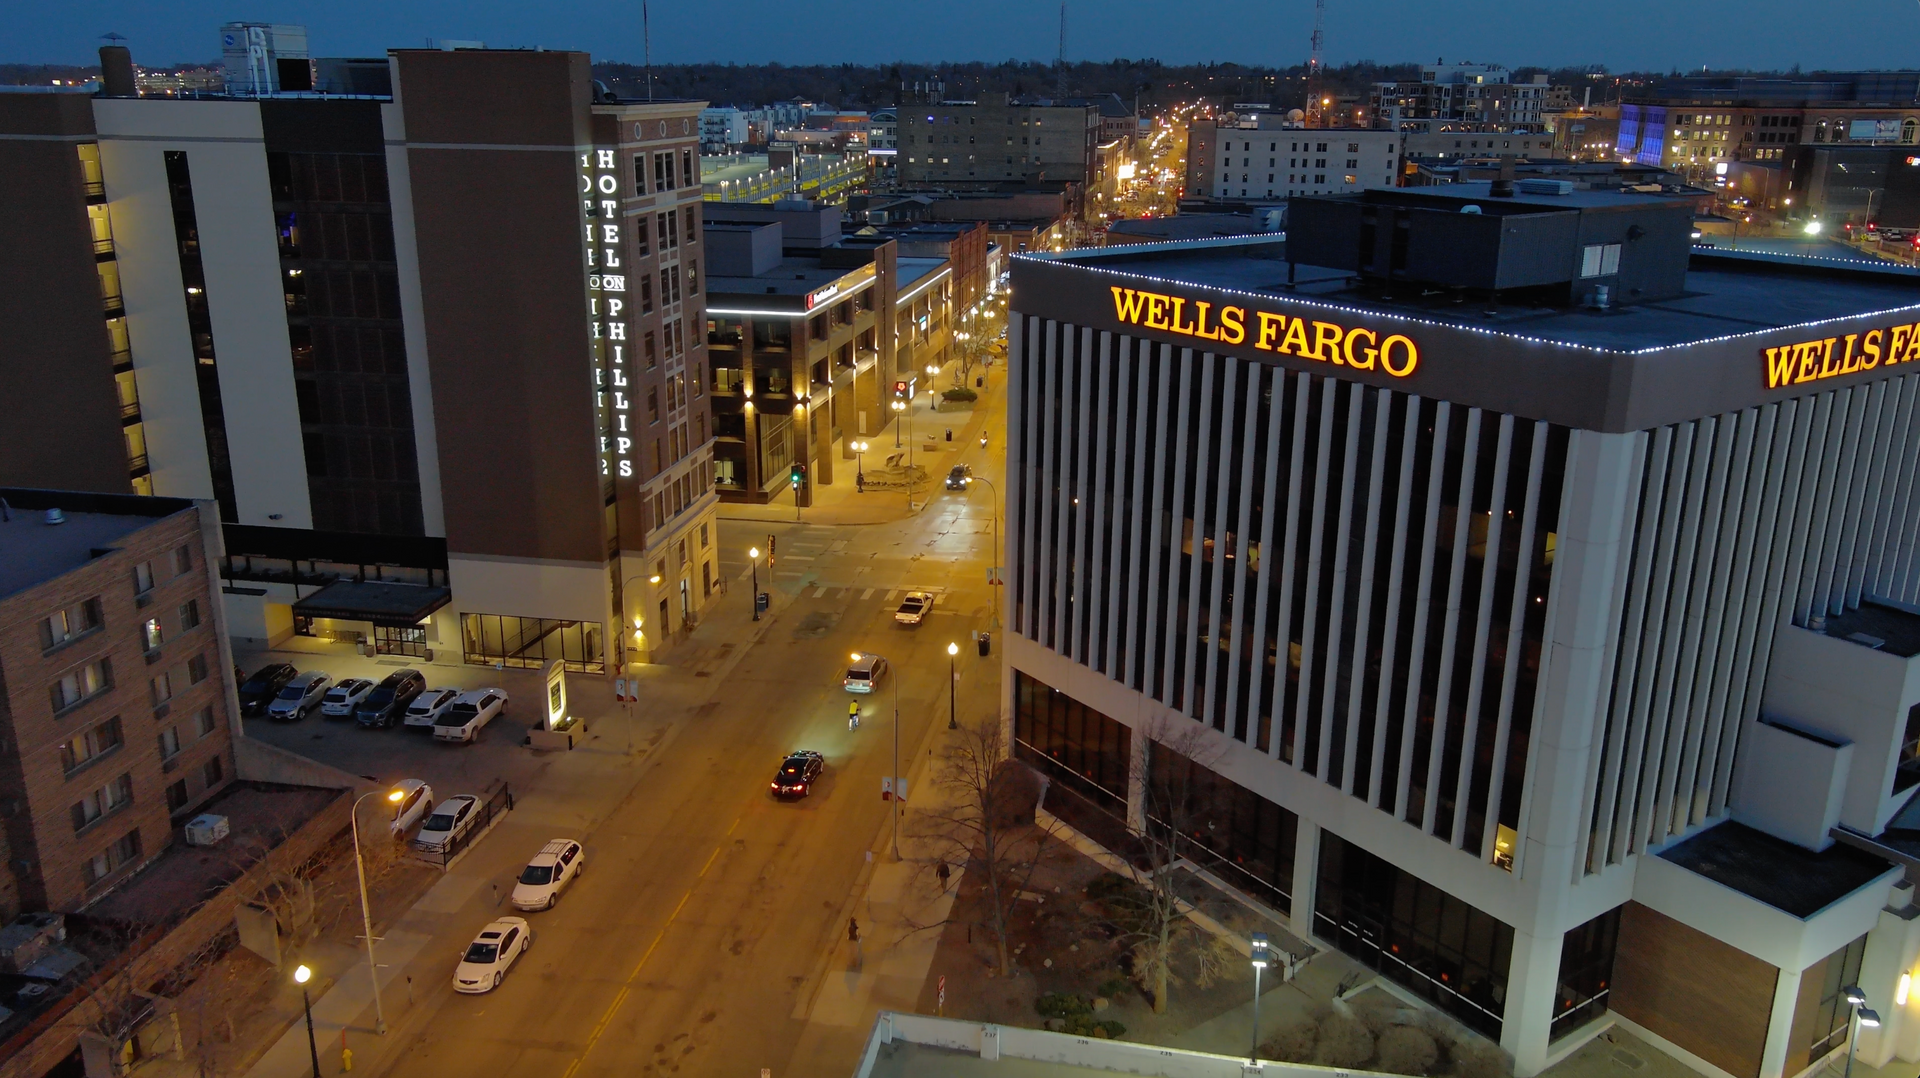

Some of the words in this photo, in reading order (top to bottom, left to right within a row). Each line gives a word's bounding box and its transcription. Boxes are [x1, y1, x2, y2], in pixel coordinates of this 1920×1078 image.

[597, 149, 620, 268] HOTEL
[602, 276, 625, 291] ON
[1110, 286, 1246, 345] WELLS
[1254, 311, 1419, 378] FARGO
[1765, 329, 1884, 389] WELLS
[604, 298, 632, 477] PHILLIPS
